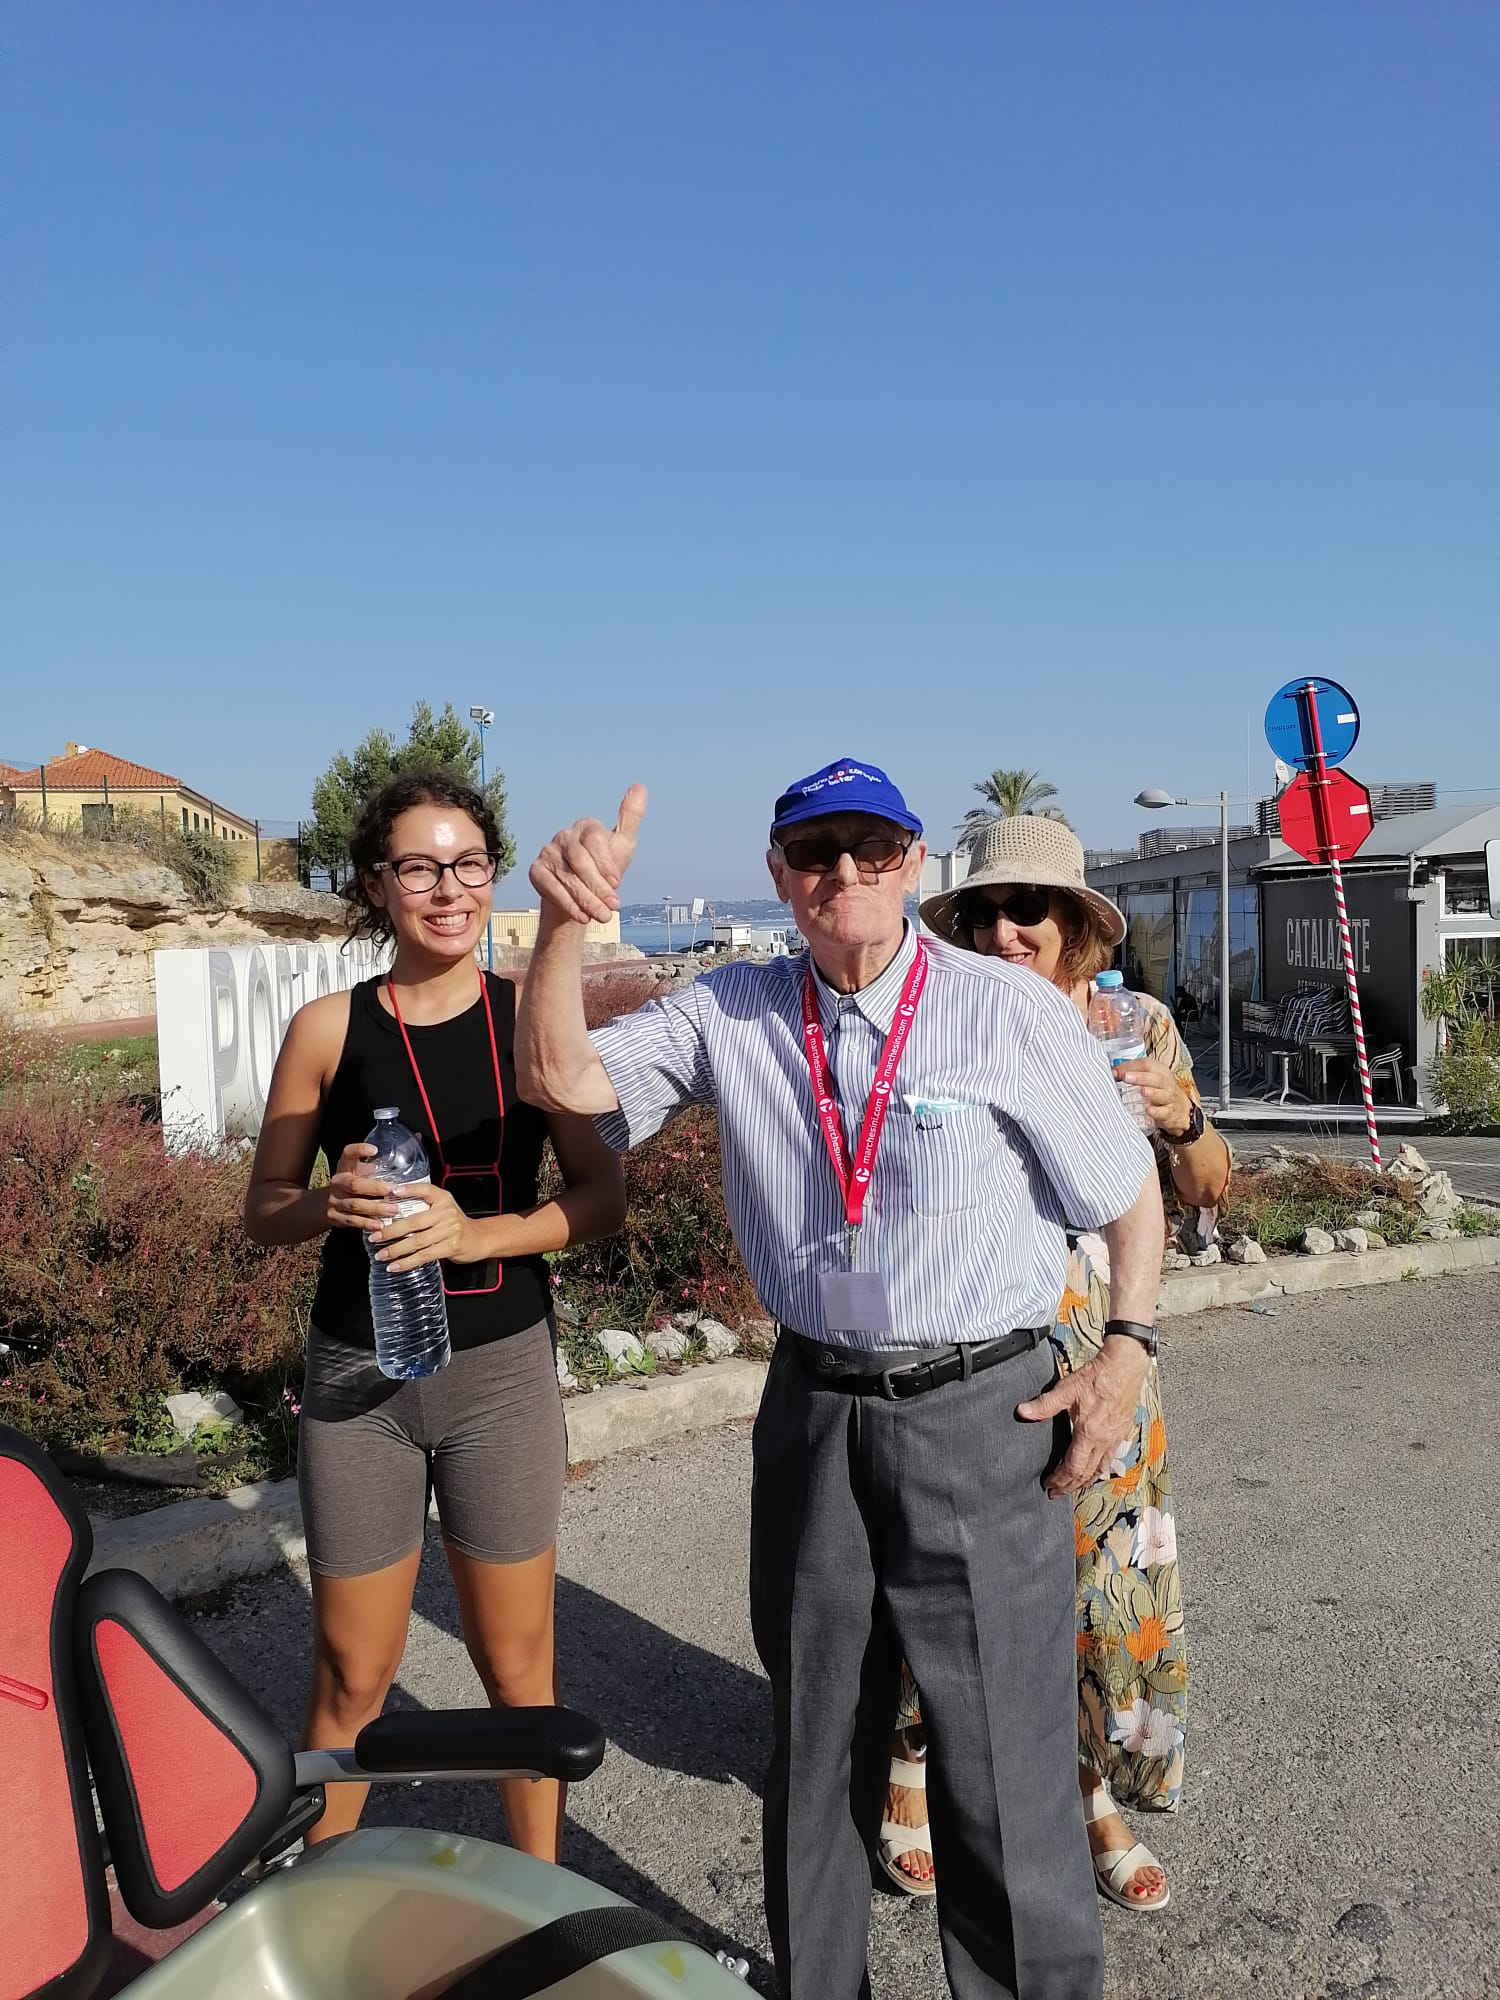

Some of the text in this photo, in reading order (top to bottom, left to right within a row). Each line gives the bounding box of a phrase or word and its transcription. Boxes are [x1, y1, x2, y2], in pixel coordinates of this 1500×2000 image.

[1286, 917, 1371, 974] CATALAZTE
[810, 1037, 826, 1096] marchesini.com
[883, 1019, 908, 1078] marchesini.com
[863, 1098, 884, 1164] marchesini.com
